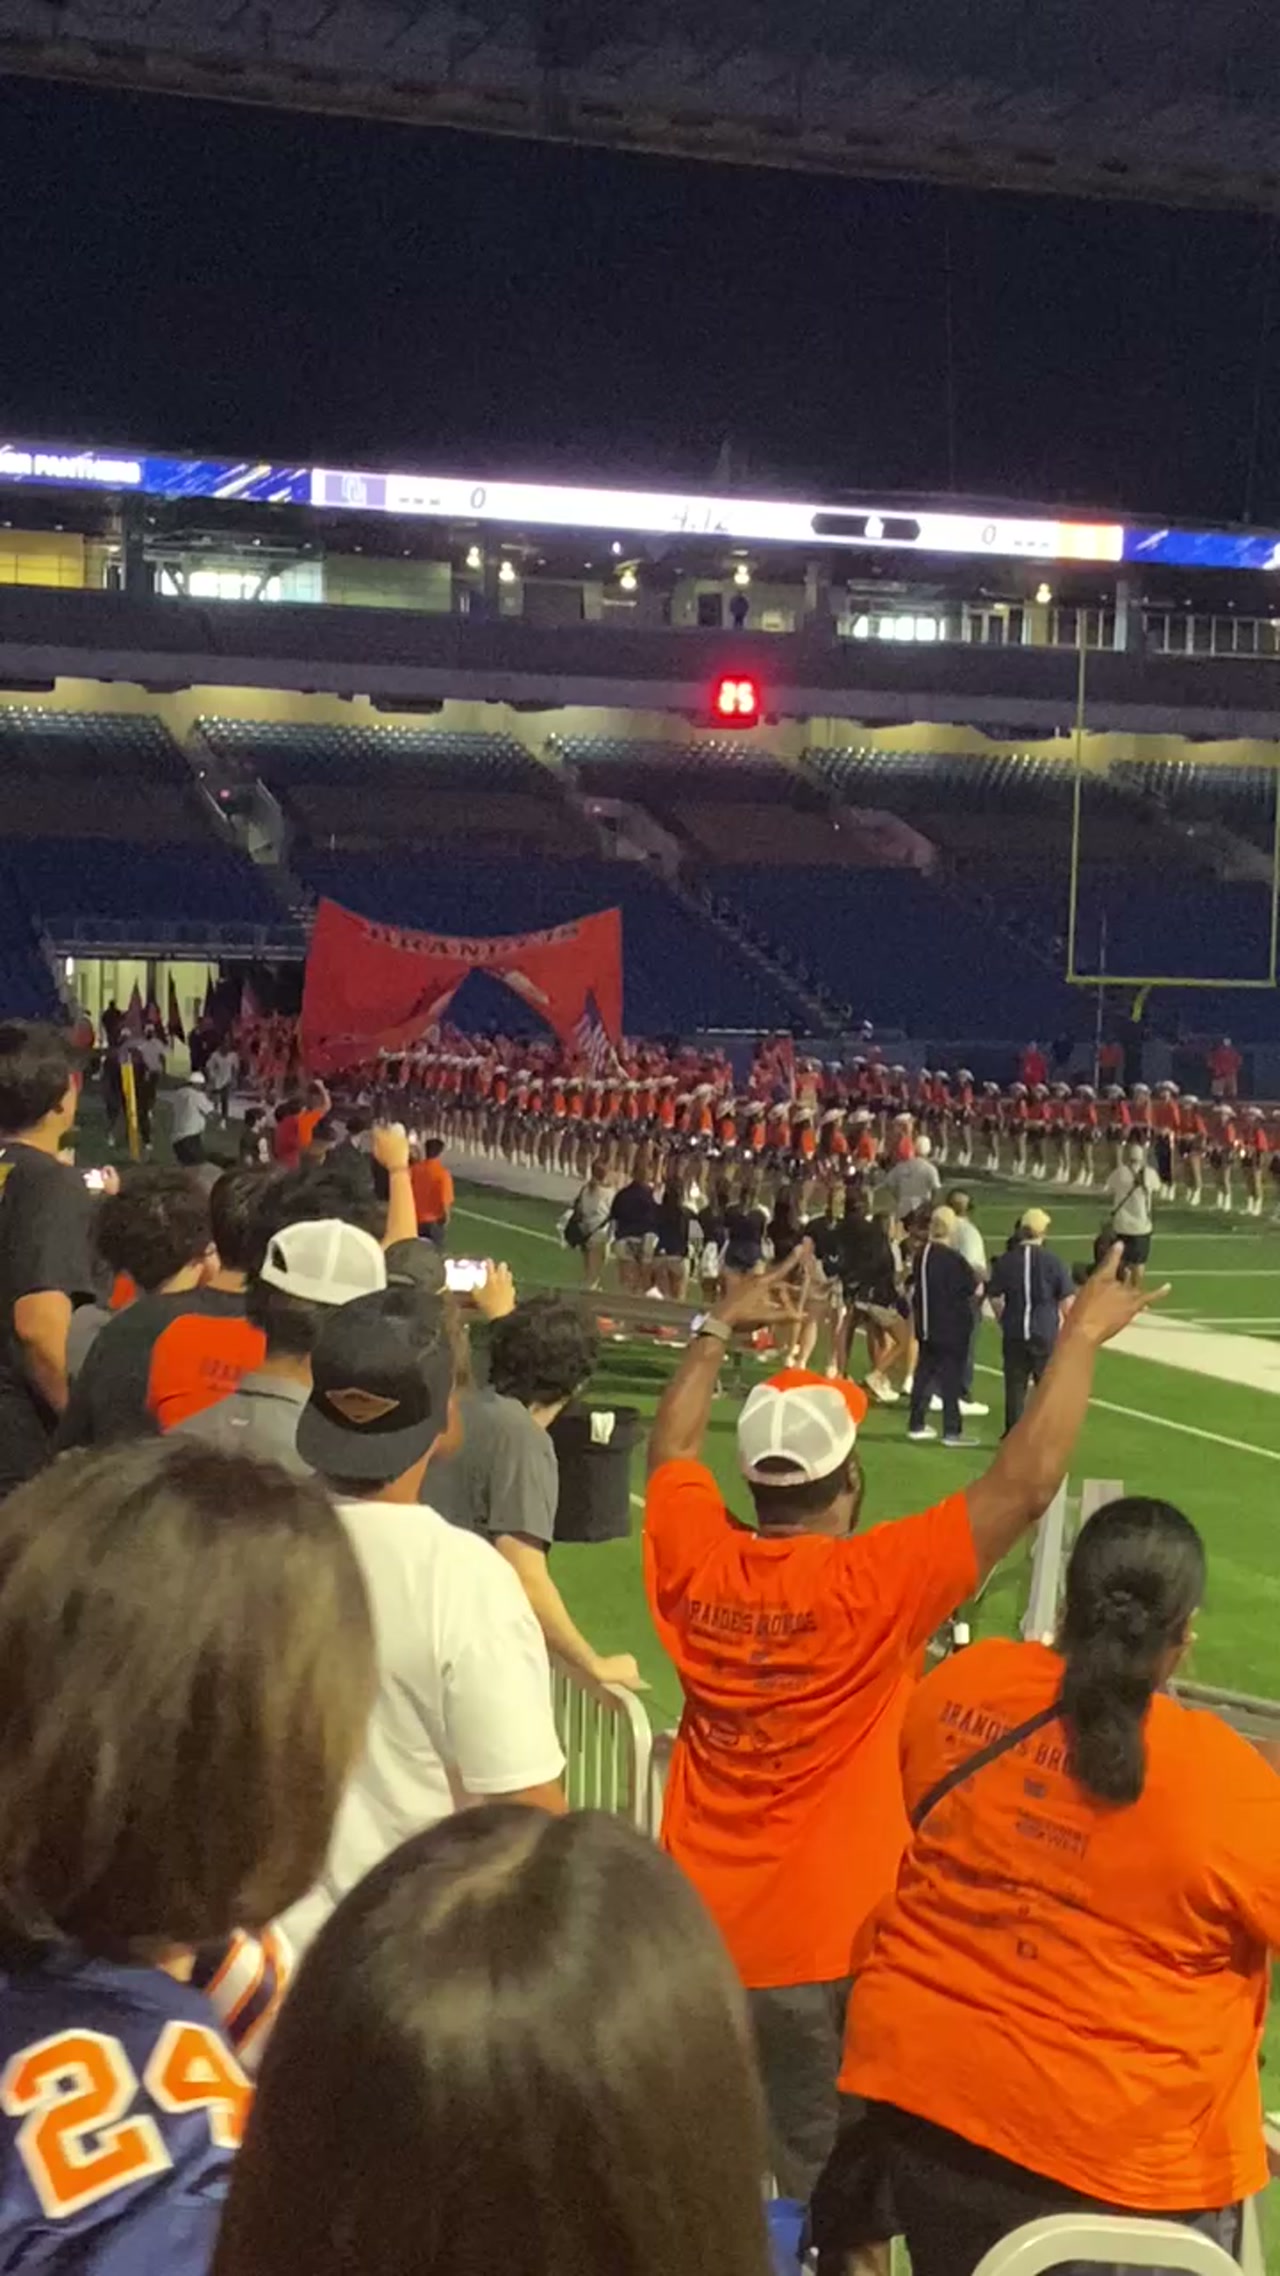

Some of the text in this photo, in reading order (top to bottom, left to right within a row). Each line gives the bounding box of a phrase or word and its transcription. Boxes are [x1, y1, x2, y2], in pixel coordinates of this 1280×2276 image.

[469, 487, 486, 509] 0
[981, 523, 997, 546] 0
[0, 2020, 256, 2219] 24
